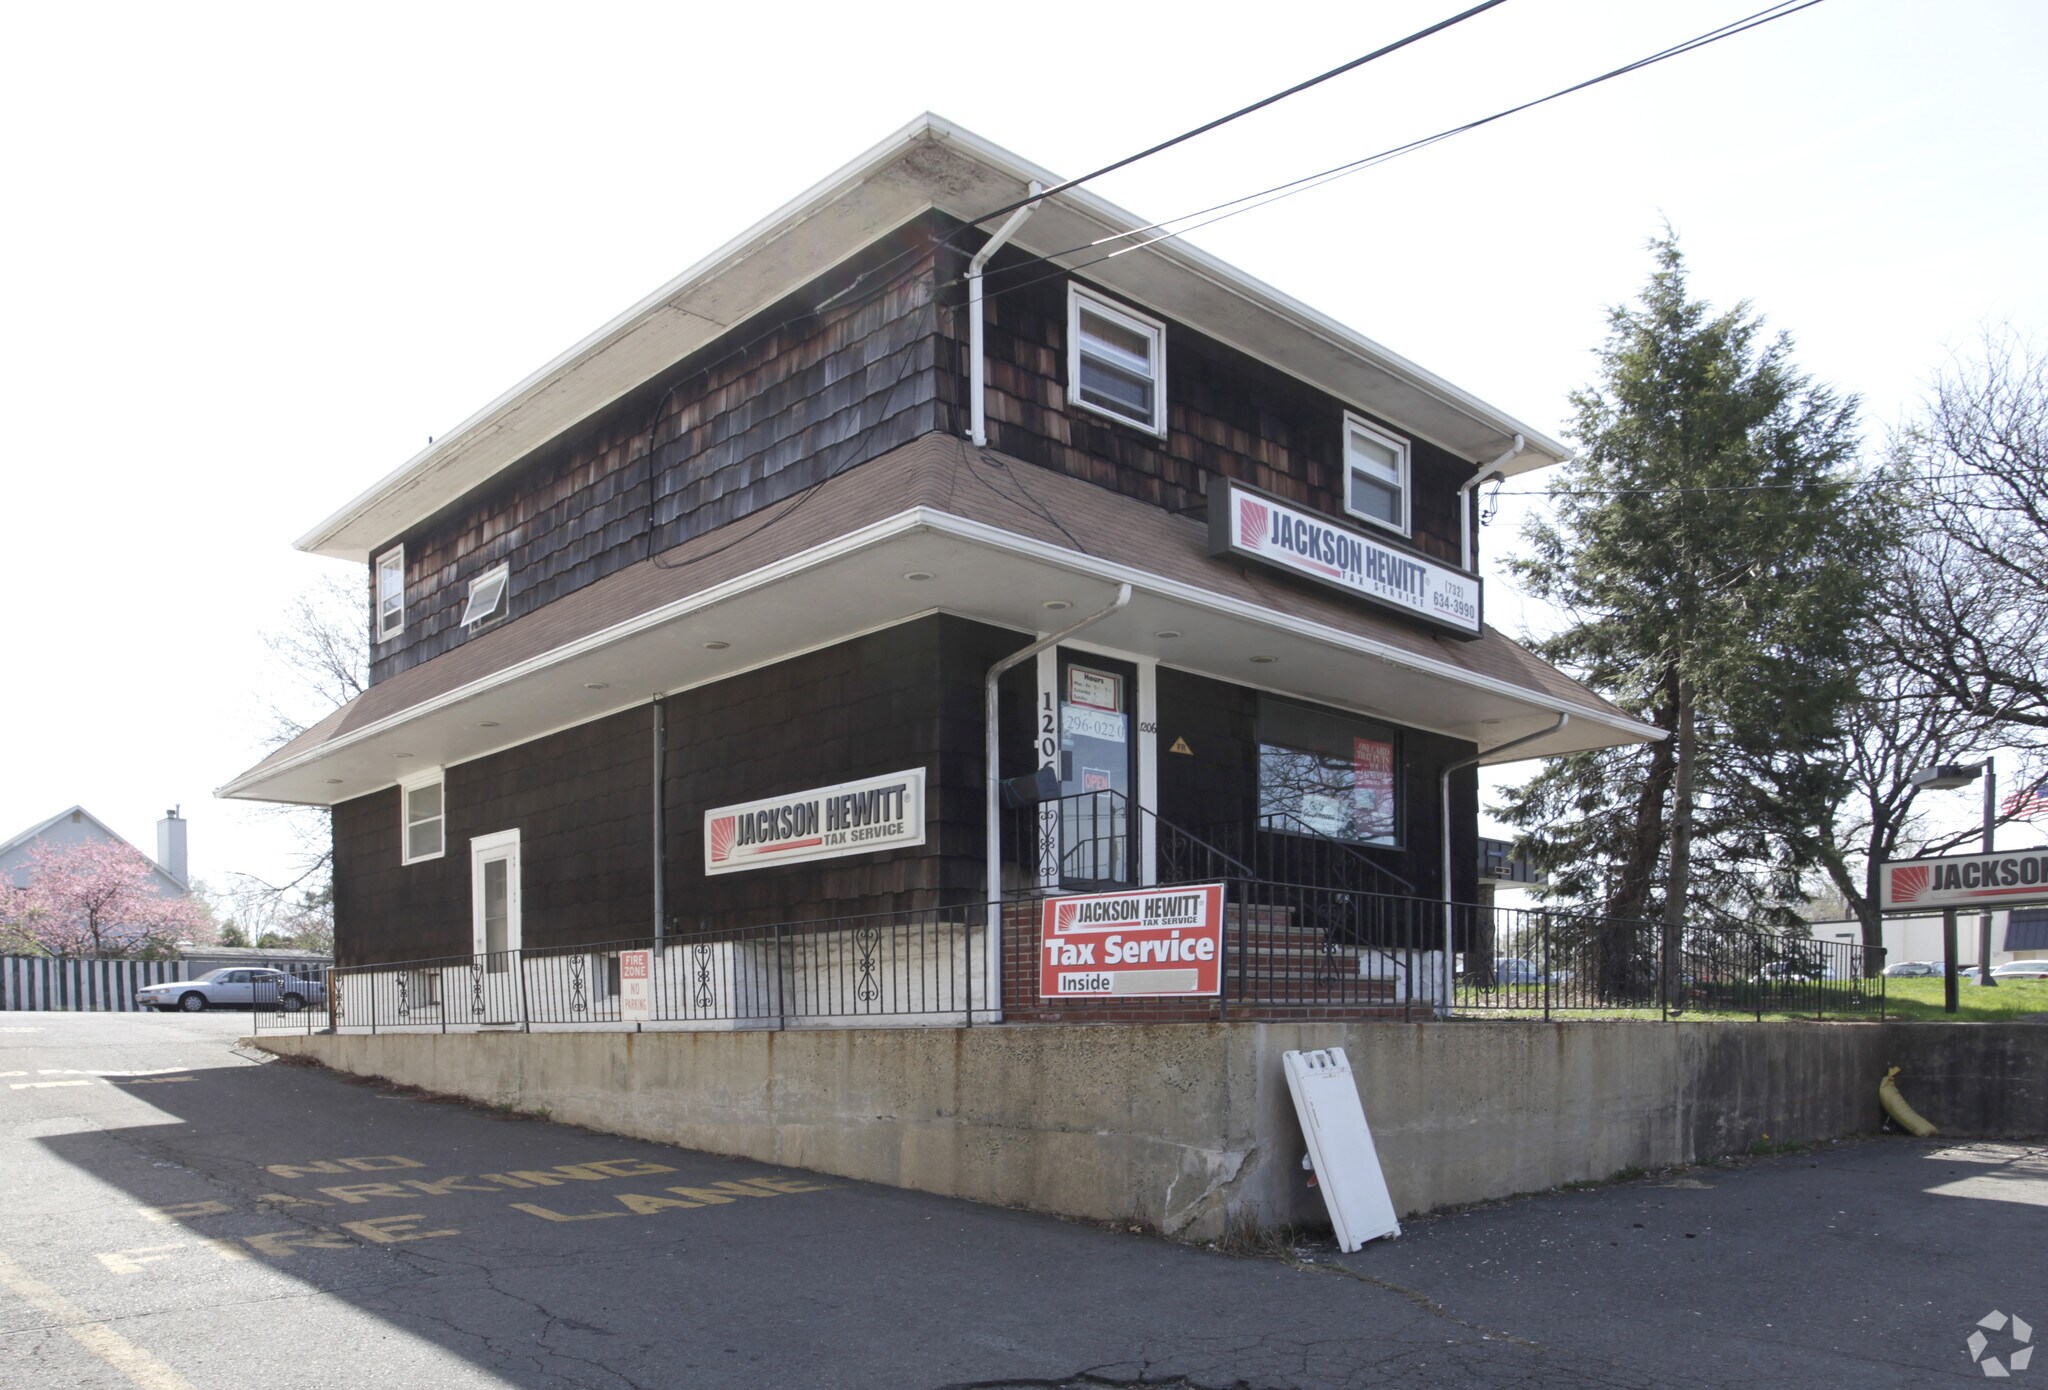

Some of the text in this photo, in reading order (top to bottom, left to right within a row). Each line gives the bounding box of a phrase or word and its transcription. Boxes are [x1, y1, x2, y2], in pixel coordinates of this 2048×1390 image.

[1271, 511, 1427, 597] JACKSON HEWITT
[1341, 570, 1425, 608] TAX SERVICE
[1444, 579, 1464, 598] (732)
[1433, 591, 1475, 619] 634-3990
[1084, 674, 1104, 684] Hours
[1085, 773, 1108, 790] OPEN
[737, 783, 906, 846] JACKSON HEWITT
[824, 822, 904, 846] TAX SERVICE
[1078, 894, 1200, 923] JACKSON HEWITT
[1162, 916, 1197, 925] SERVICE
[1045, 930, 1214, 966] Tax Service
[624, 966, 646, 976] ZONE
[625, 955, 644, 966] FIRE
[631, 983, 640, 995] NO
[1062, 974, 1110, 990] Inside
[625, 998, 646, 1011] PARKING
[263, 1155, 427, 1179] NO
[509, 1175, 848, 1222] LANE
